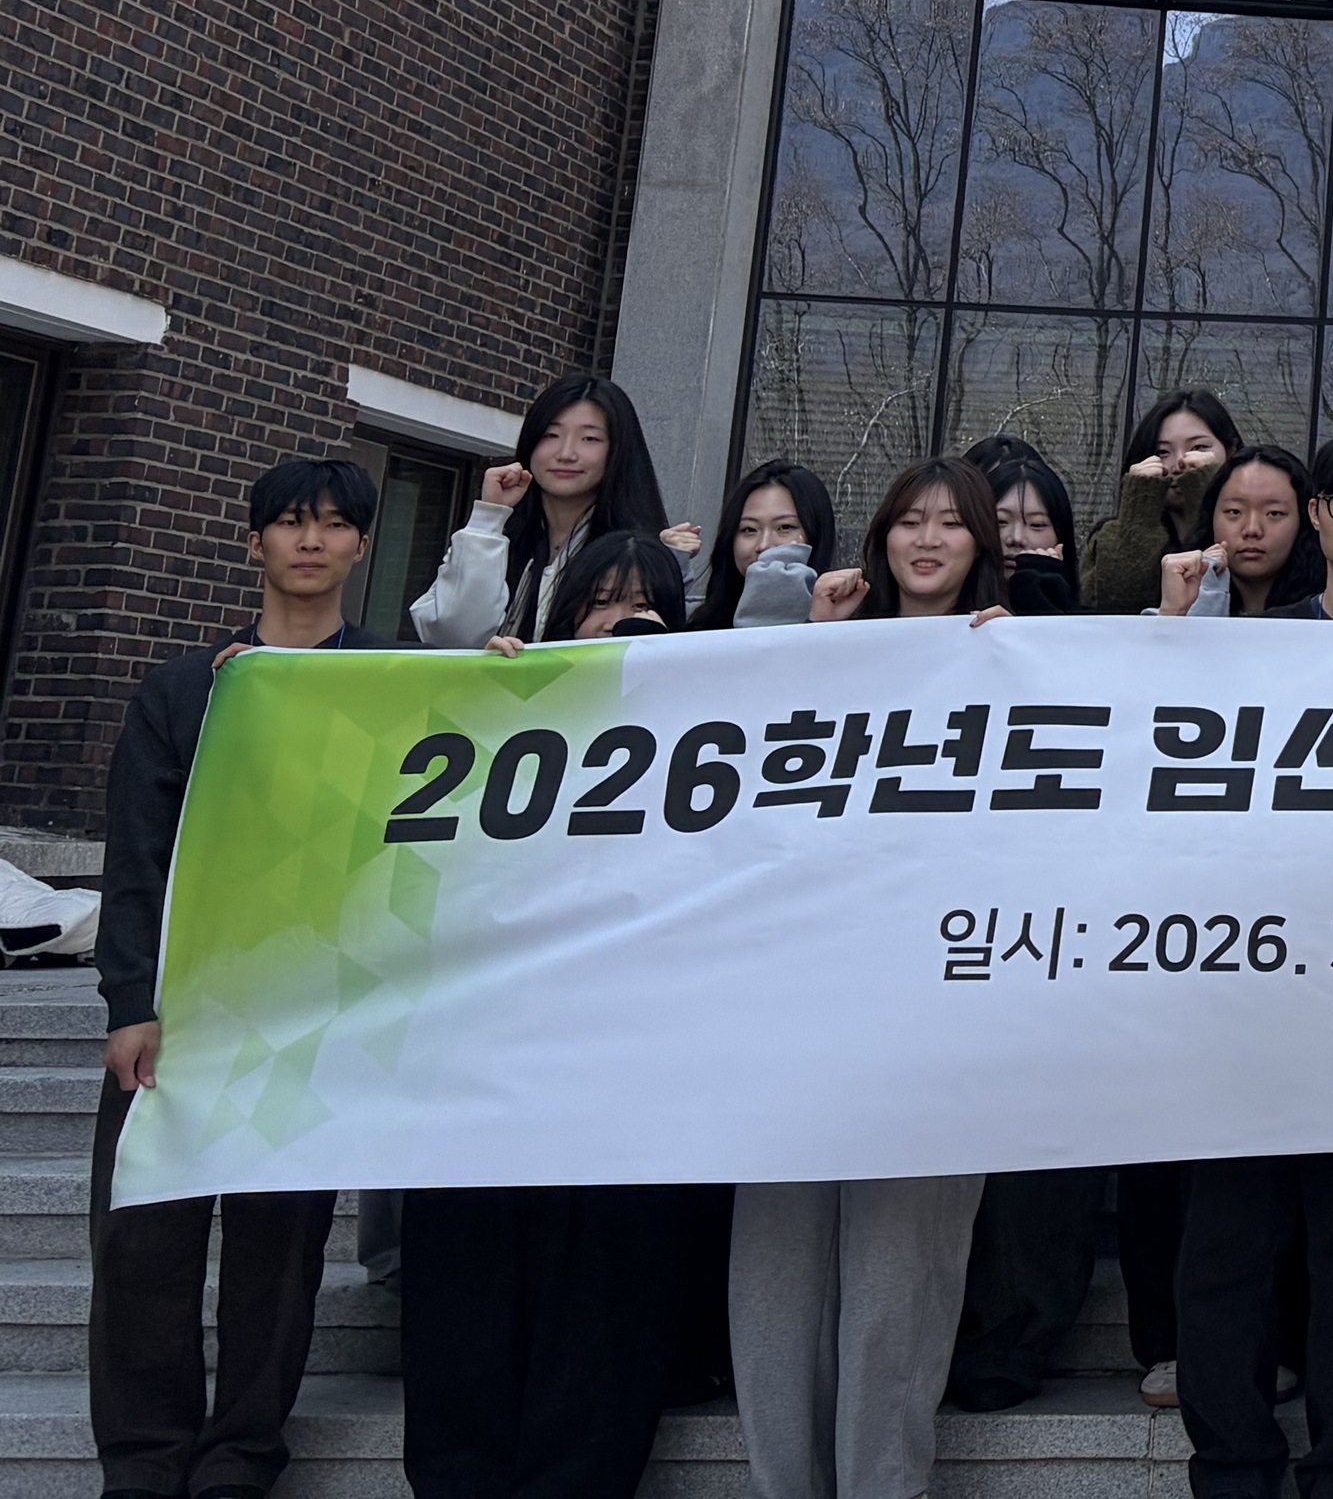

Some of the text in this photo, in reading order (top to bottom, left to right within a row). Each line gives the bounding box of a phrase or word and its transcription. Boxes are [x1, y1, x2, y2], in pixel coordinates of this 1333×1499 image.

[383, 703, 1112, 844] 2026학년도
[939, 906, 1087, 981] 일시:
[1108, 912, 1307, 976] 2026.
